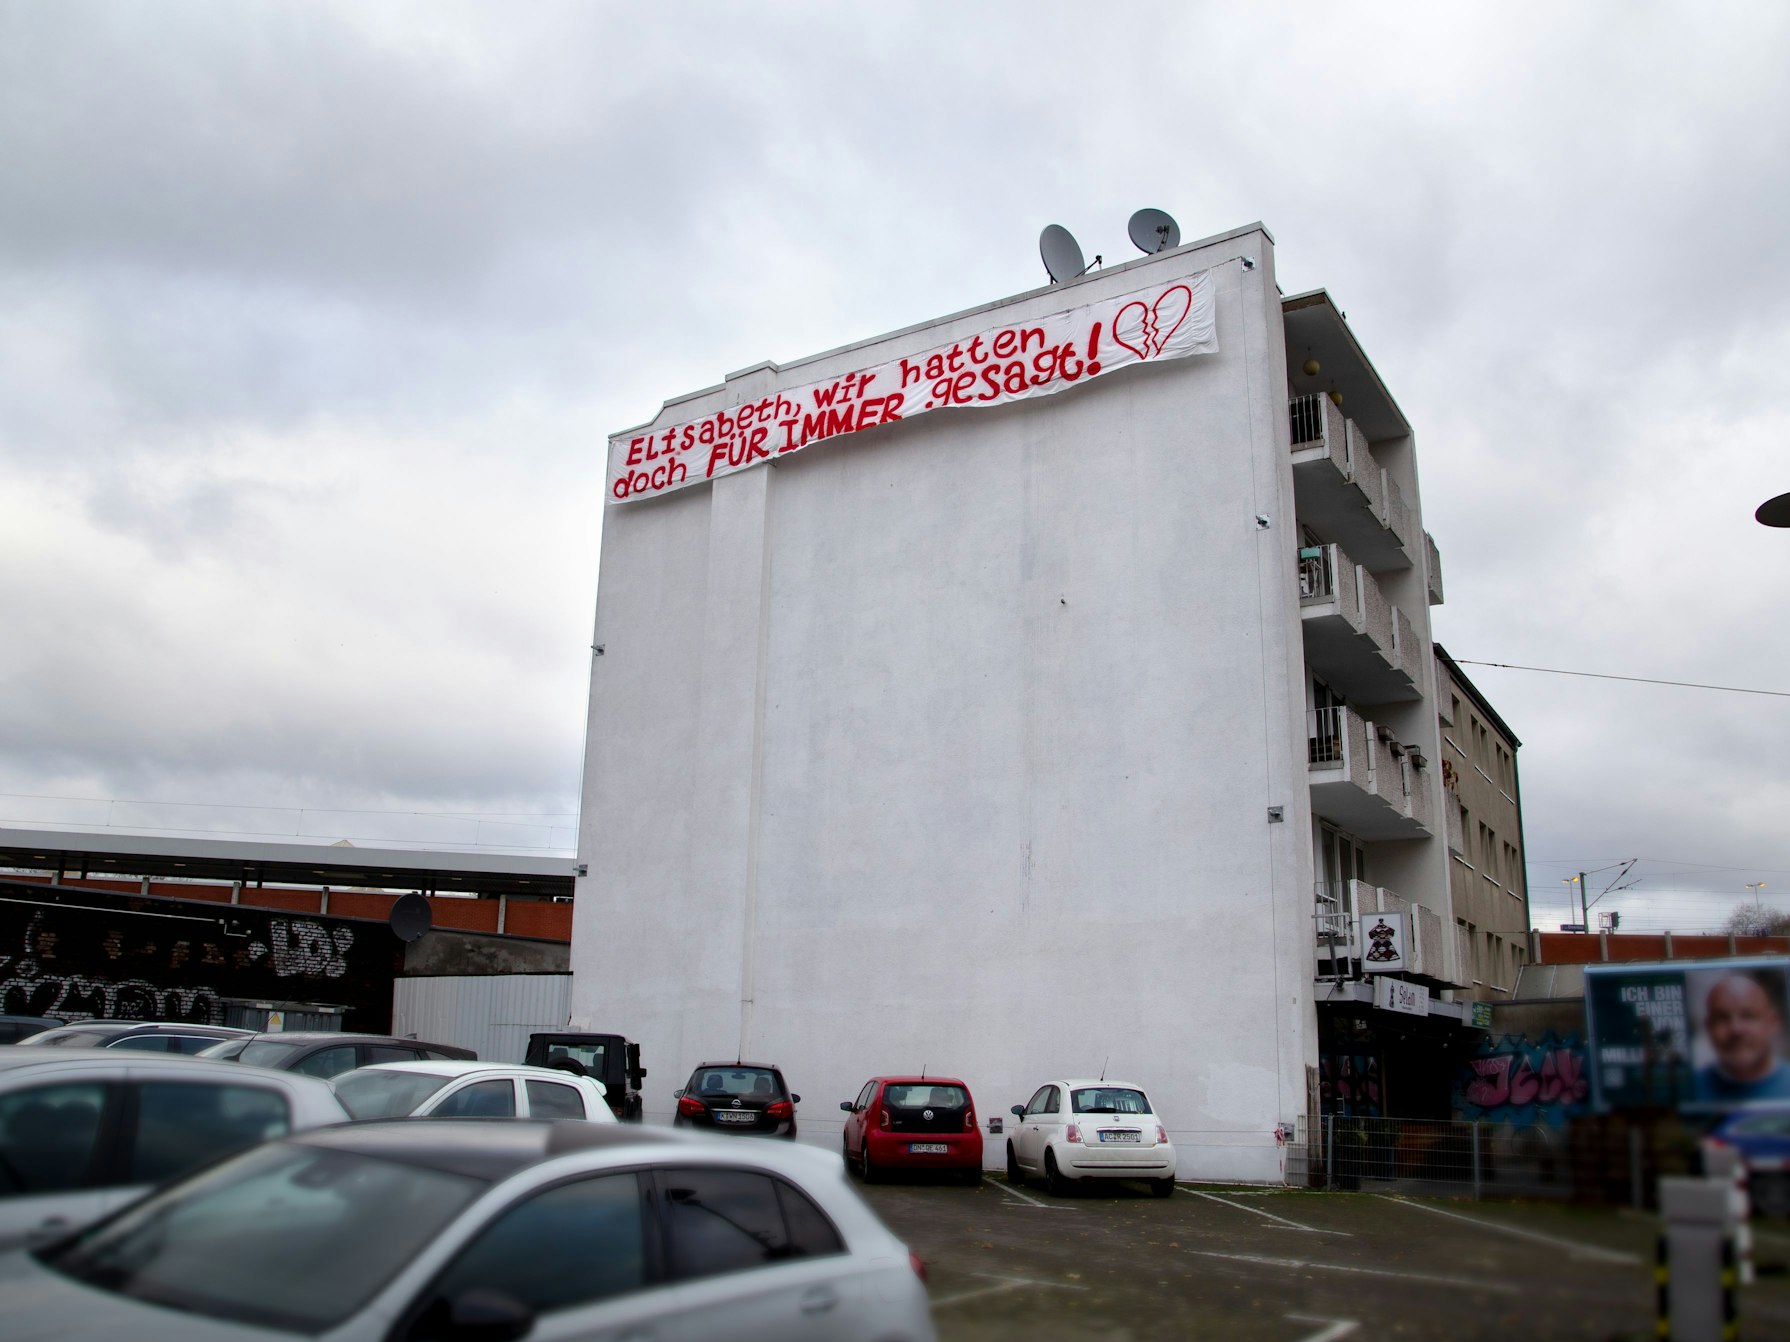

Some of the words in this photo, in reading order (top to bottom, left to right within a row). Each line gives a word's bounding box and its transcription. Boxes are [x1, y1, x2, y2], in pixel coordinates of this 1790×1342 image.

[813, 372, 876, 410] wir
[900, 327, 1045, 389] hatten
[613, 456, 688, 499] doch
[706, 426, 770, 478] FÜR
[778, 392, 905, 453] IMMER
[1621, 986, 1648, 1002] ICH
[1654, 985, 1682, 1001] BIN
[1636, 1001, 1683, 1017] EINER
